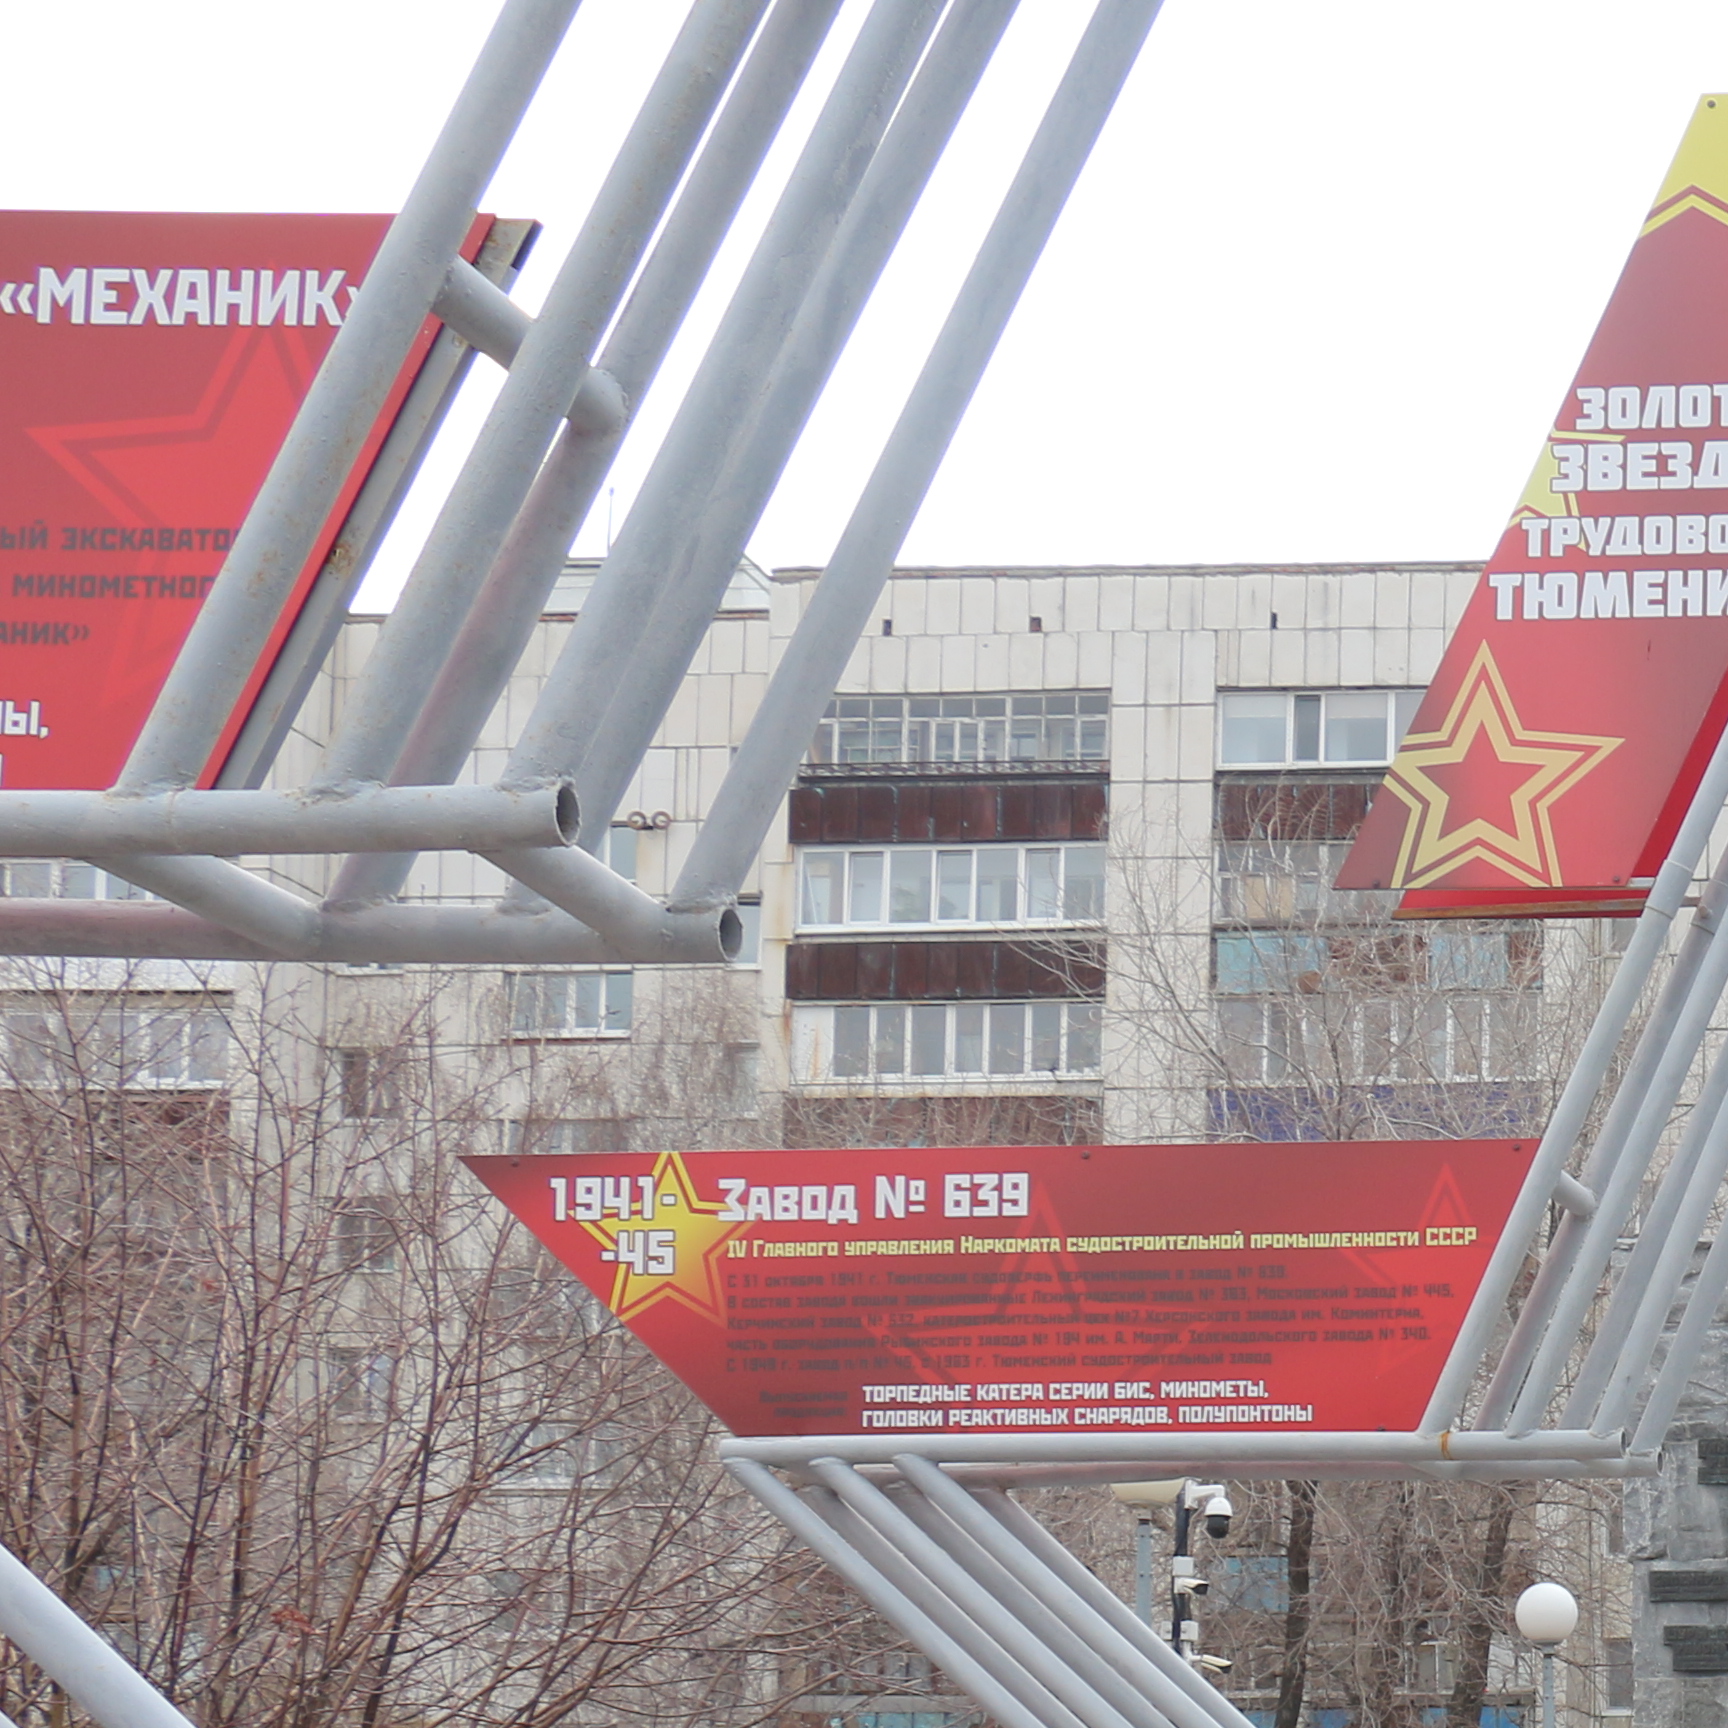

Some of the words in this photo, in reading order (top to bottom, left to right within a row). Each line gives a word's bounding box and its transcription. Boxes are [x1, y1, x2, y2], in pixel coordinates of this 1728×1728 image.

[61, 527, 236, 552] экскавато
[12, 574, 214, 599] минометног
[717, 1178, 858, 1225] Завод
[874, 1174, 925, 1219] №
[943, 1172, 1029, 1218] 639
[727, 1240, 748, 1258] IV
[753, 1238, 839, 1258] Главного
[844, 1239, 954, 1256] управления
[960, 1234, 1061, 1254] Наркомата
[1066, 1230, 1244, 1254] судостроительной
[1250, 1231, 1419, 1249] промышленности
[1426, 1227, 1477, 1246] СССР
[862, 1384, 972, 1404] ТОРПЕДНЫЕ
[976, 1383, 1044, 1401] КАТЕРА
[1049, 1382, 1109, 1400] СЕРИИ
[1114, 1381, 1155, 1400] БИС,
[1160, 1380, 1269, 1399] МИНОМЕТЫ,
[862, 1410, 943, 1427] ГОЛОВКИ
[948, 1408, 1069, 1426] РЕАКТИВНЫХ
[1074, 1406, 1173, 1426] СНАРЯДОВ,
[1178, 1404, 1313, 1423] ПОЛУПОНТОНЫ
